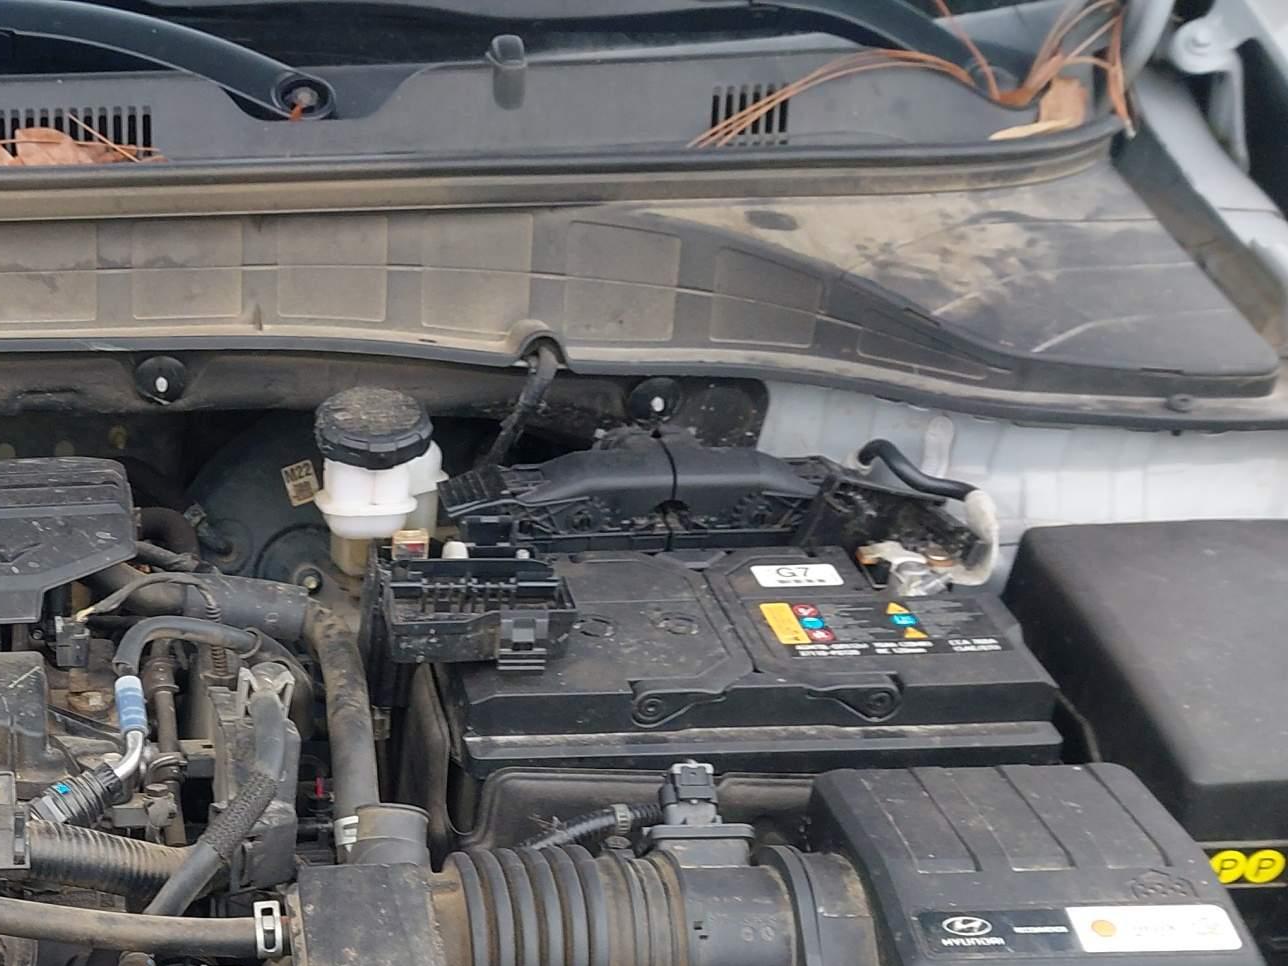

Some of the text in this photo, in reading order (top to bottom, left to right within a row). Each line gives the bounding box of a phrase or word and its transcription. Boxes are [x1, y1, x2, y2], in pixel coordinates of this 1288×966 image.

[776, 566, 809, 579] G7
[1255, 857, 1276, 877] P
[940, 936, 1006, 947] HYUNDAI
